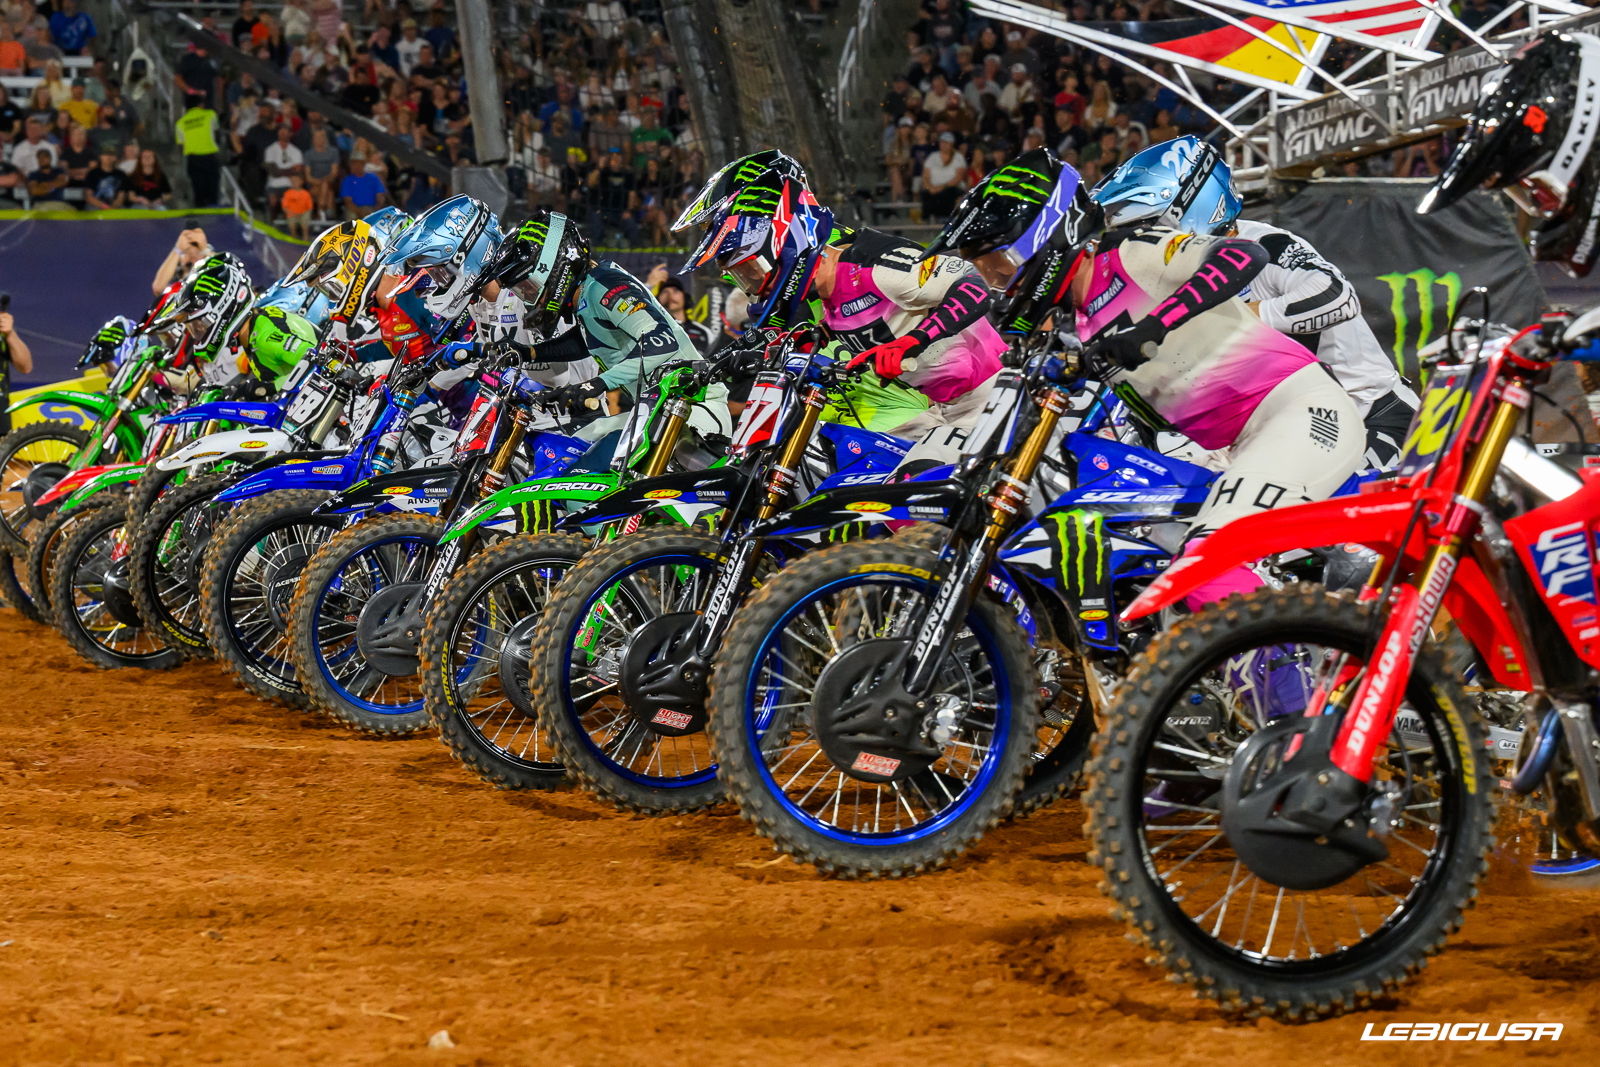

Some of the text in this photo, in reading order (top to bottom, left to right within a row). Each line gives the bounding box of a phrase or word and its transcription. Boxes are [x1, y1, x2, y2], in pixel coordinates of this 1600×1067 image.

[1561, 78, 1596, 171] OAKLEY
[1181, 151, 1215, 207] SCO
[465, 201, 490, 251] SCOT
[341, 234, 367, 281] 100%
[366, 249, 374, 263] BELL
[343, 266, 370, 318] ROCKSTAR
[605, 284, 630, 300] YAMAHA
[783, 256, 807, 301] MONSTER
[1093, 277, 1124, 312] YAMAHA
[849, 293, 879, 314] YAMAHA
[1291, 299, 1358, 333] CLUBM
[838, 473, 891, 486] YZ
[1124, 454, 1168, 476] GYTR
[543, 482, 611, 493] CIRCUIT
[1073, 491, 1140, 502] YZ
[916, 506, 944, 514] YAMAHA
[426, 536, 459, 601] DUNLOP
[1536, 521, 1592, 598] CRF
[705, 544, 740, 629] DUNLOP
[1412, 554, 1453, 648] SHOWA
[913, 565, 958, 662] DUNLOP
[1347, 629, 1401, 757] DUNLOP
[652, 716, 687, 729] SPEED
[659, 708, 692, 722] LIGHT
[1396, 716, 1428, 734] YAMA
[859, 753, 900, 768] LIGHT
